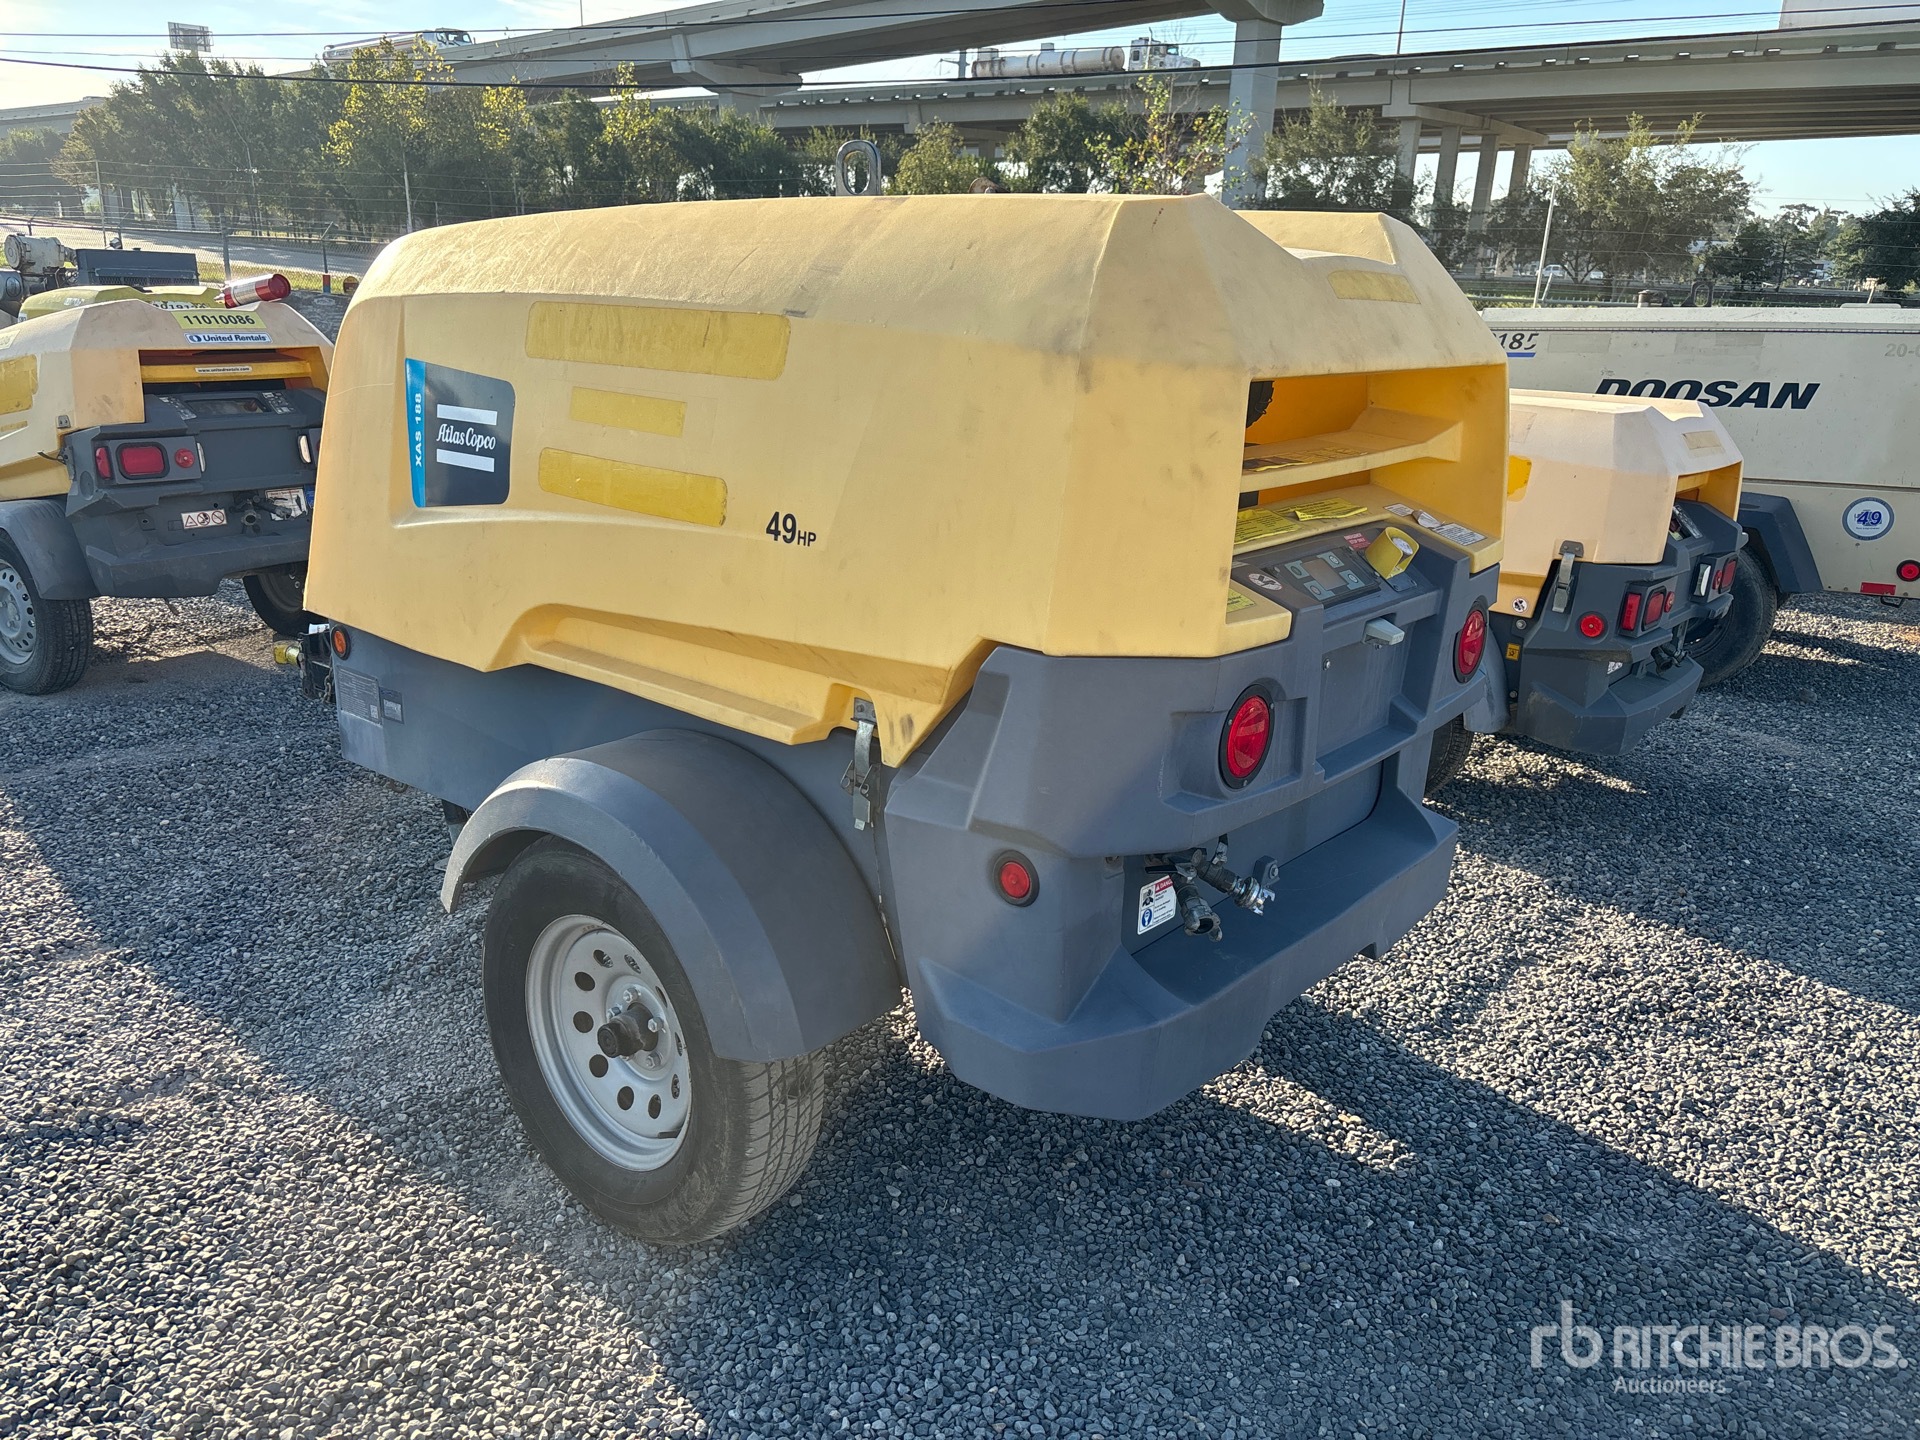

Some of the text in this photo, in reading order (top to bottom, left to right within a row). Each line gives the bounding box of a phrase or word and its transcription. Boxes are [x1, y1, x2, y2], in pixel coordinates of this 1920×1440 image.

[183, 314, 255, 325] 11010086
[203, 333, 267, 342] United Rentals
[1493, 332, 1539, 350] 185
[414, 393, 422, 467] XAS 188
[1856, 511, 1882, 525] 49
